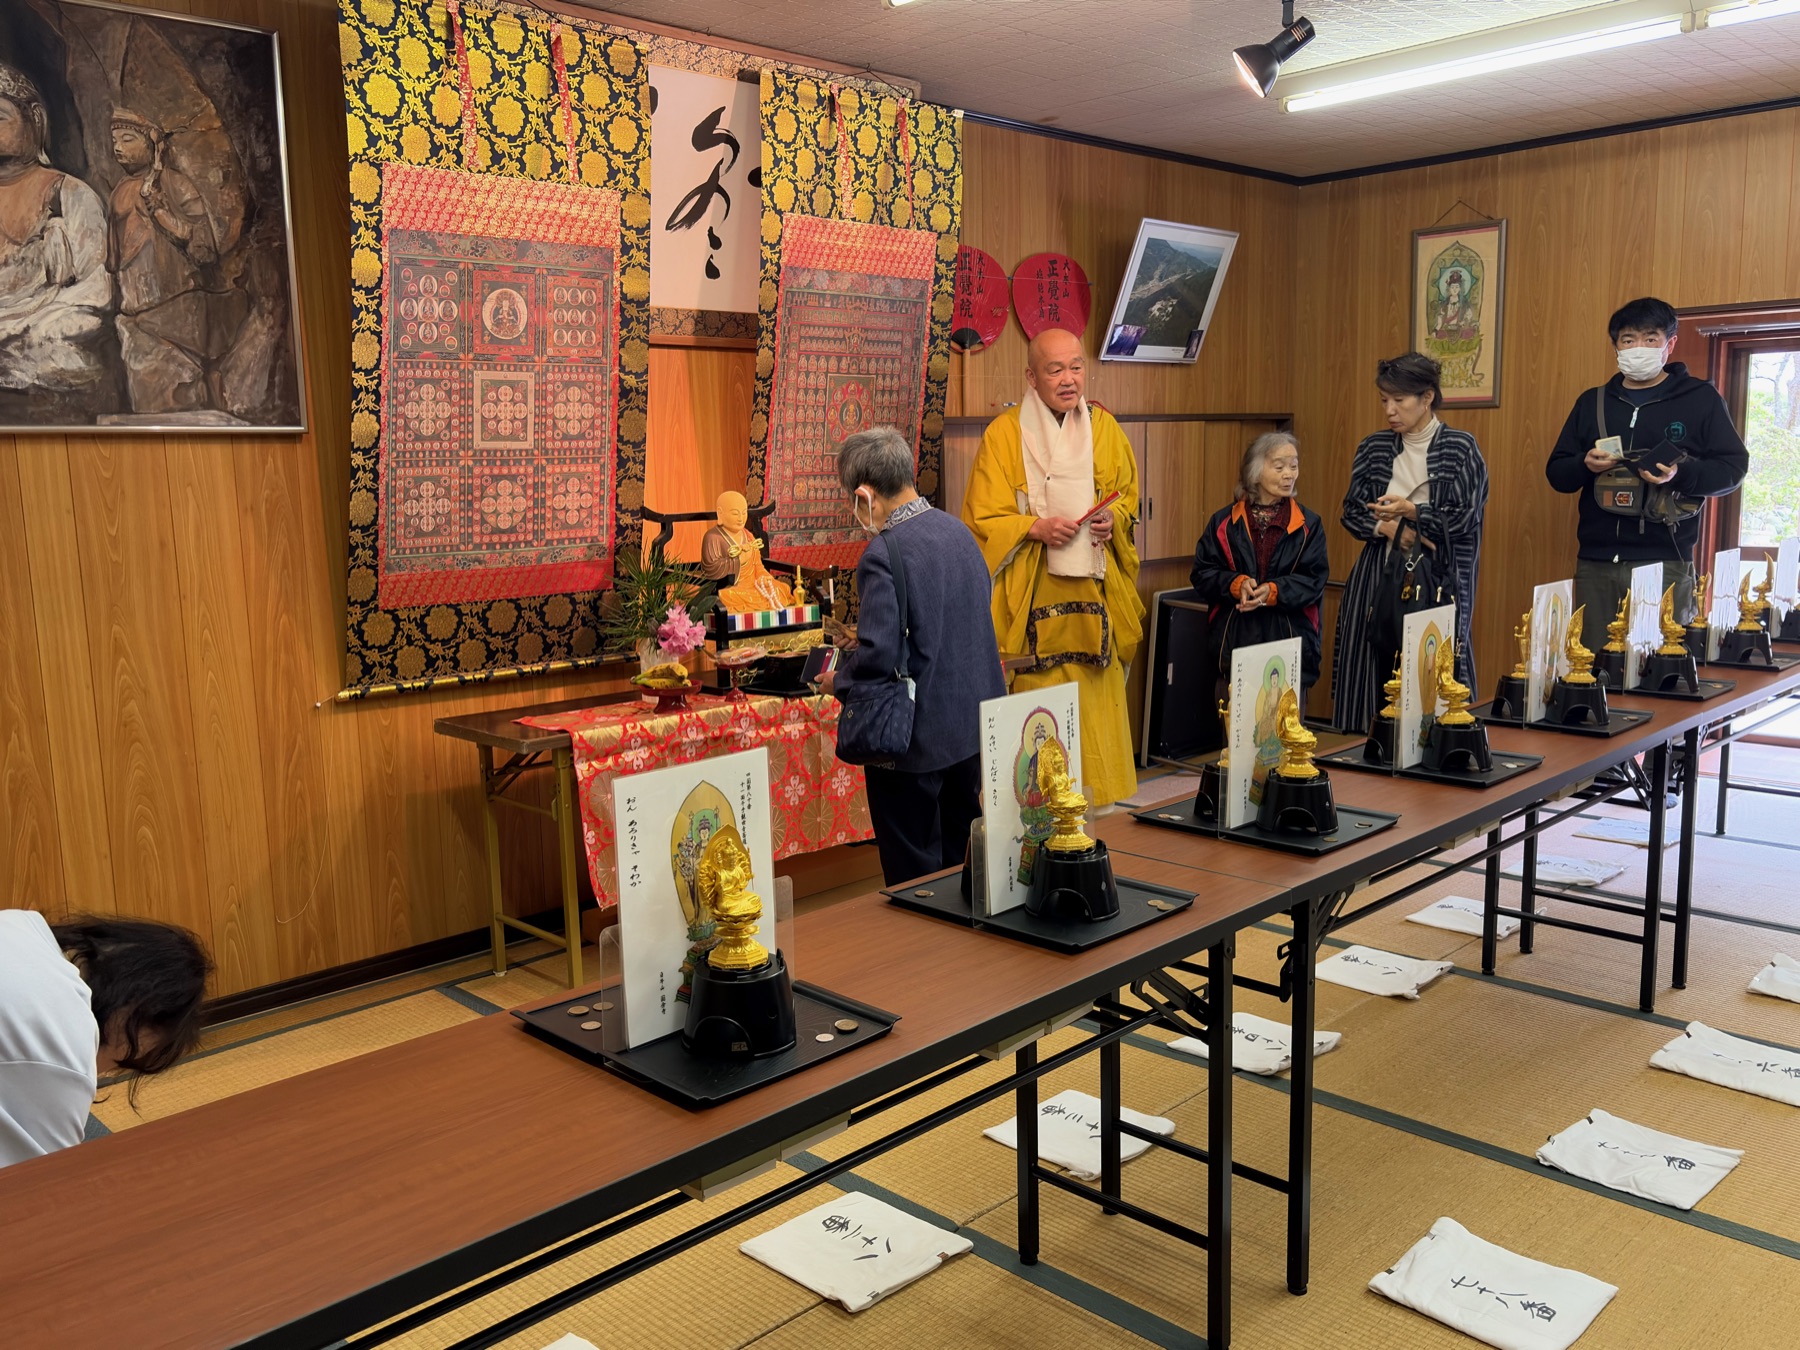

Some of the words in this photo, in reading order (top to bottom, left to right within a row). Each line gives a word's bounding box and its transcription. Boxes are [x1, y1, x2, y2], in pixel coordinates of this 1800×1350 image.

[626, 796, 638, 813] おん
[629, 864, 642, 888] そわか
